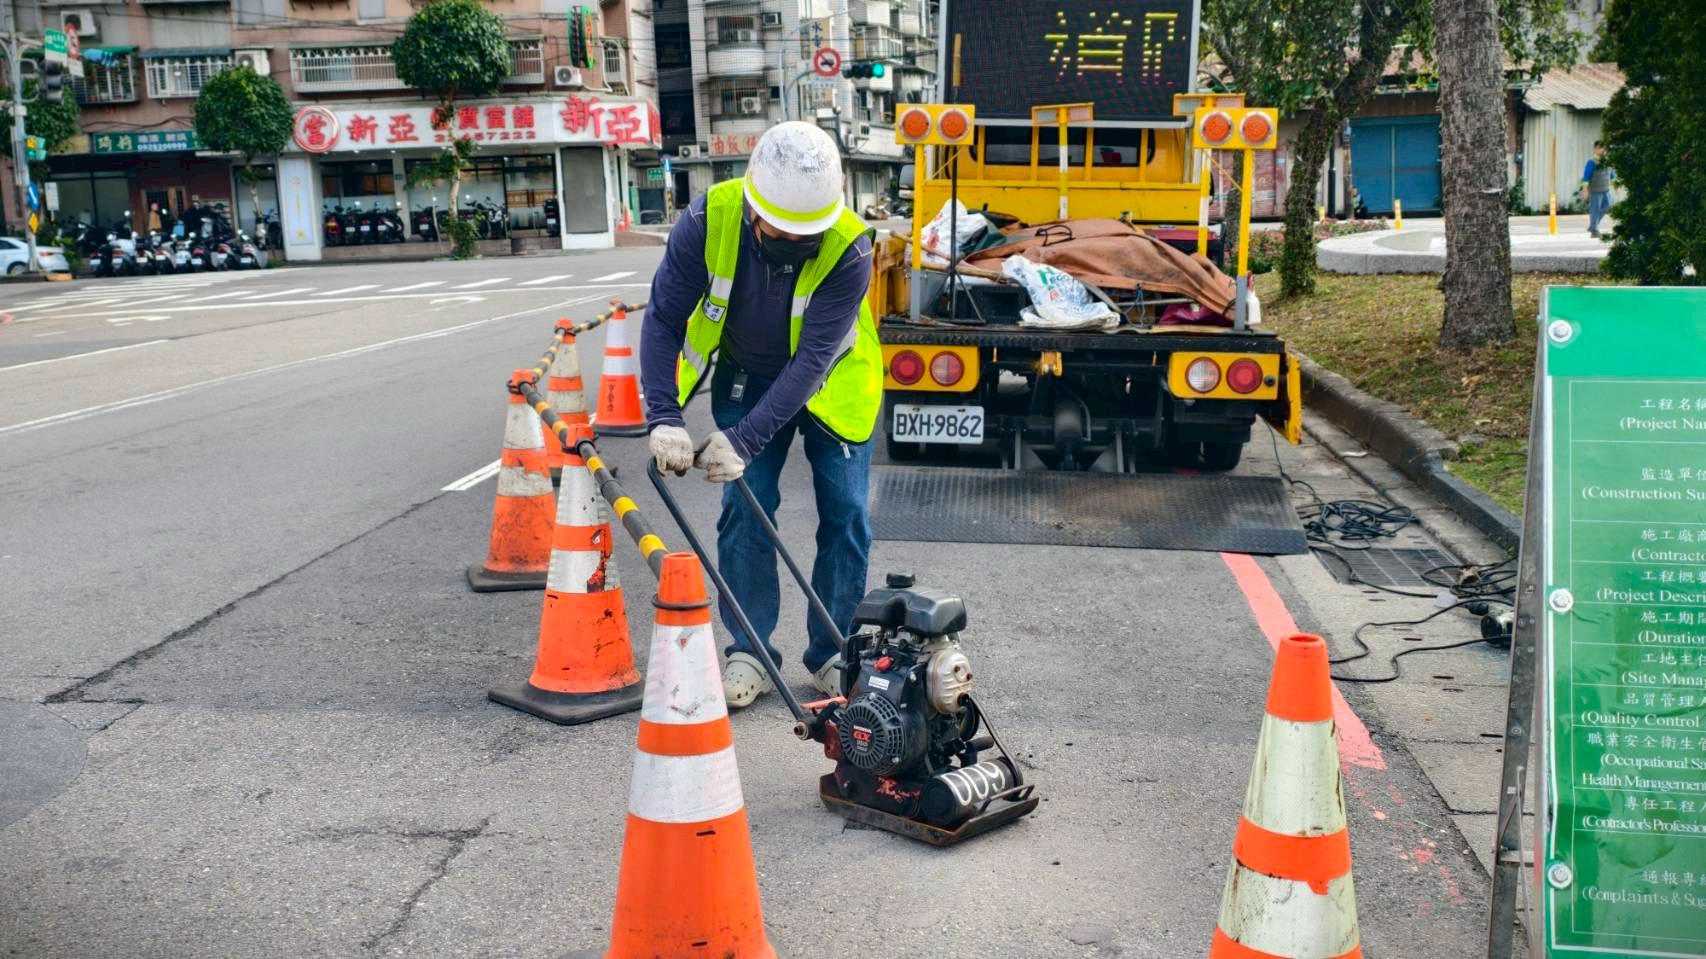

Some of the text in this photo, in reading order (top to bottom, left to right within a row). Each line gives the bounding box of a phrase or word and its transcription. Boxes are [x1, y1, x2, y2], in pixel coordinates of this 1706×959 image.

[562, 94, 647, 145] 新亞
[346, 113, 419, 144] 新亞
[1620, 416, 1677, 431] (Project
[1582, 486, 1706, 500] (Construction Su
[1597, 588, 1654, 604] (Project
[1622, 671, 1656, 684] (Site
[1581, 711, 1699, 728] (Quality Control
[1600, 753, 1688, 770] (Occupational
[1582, 772, 1621, 787] Health
[1582, 886, 1669, 905] (Complaints
[1671, 892, 1680, 906] &
